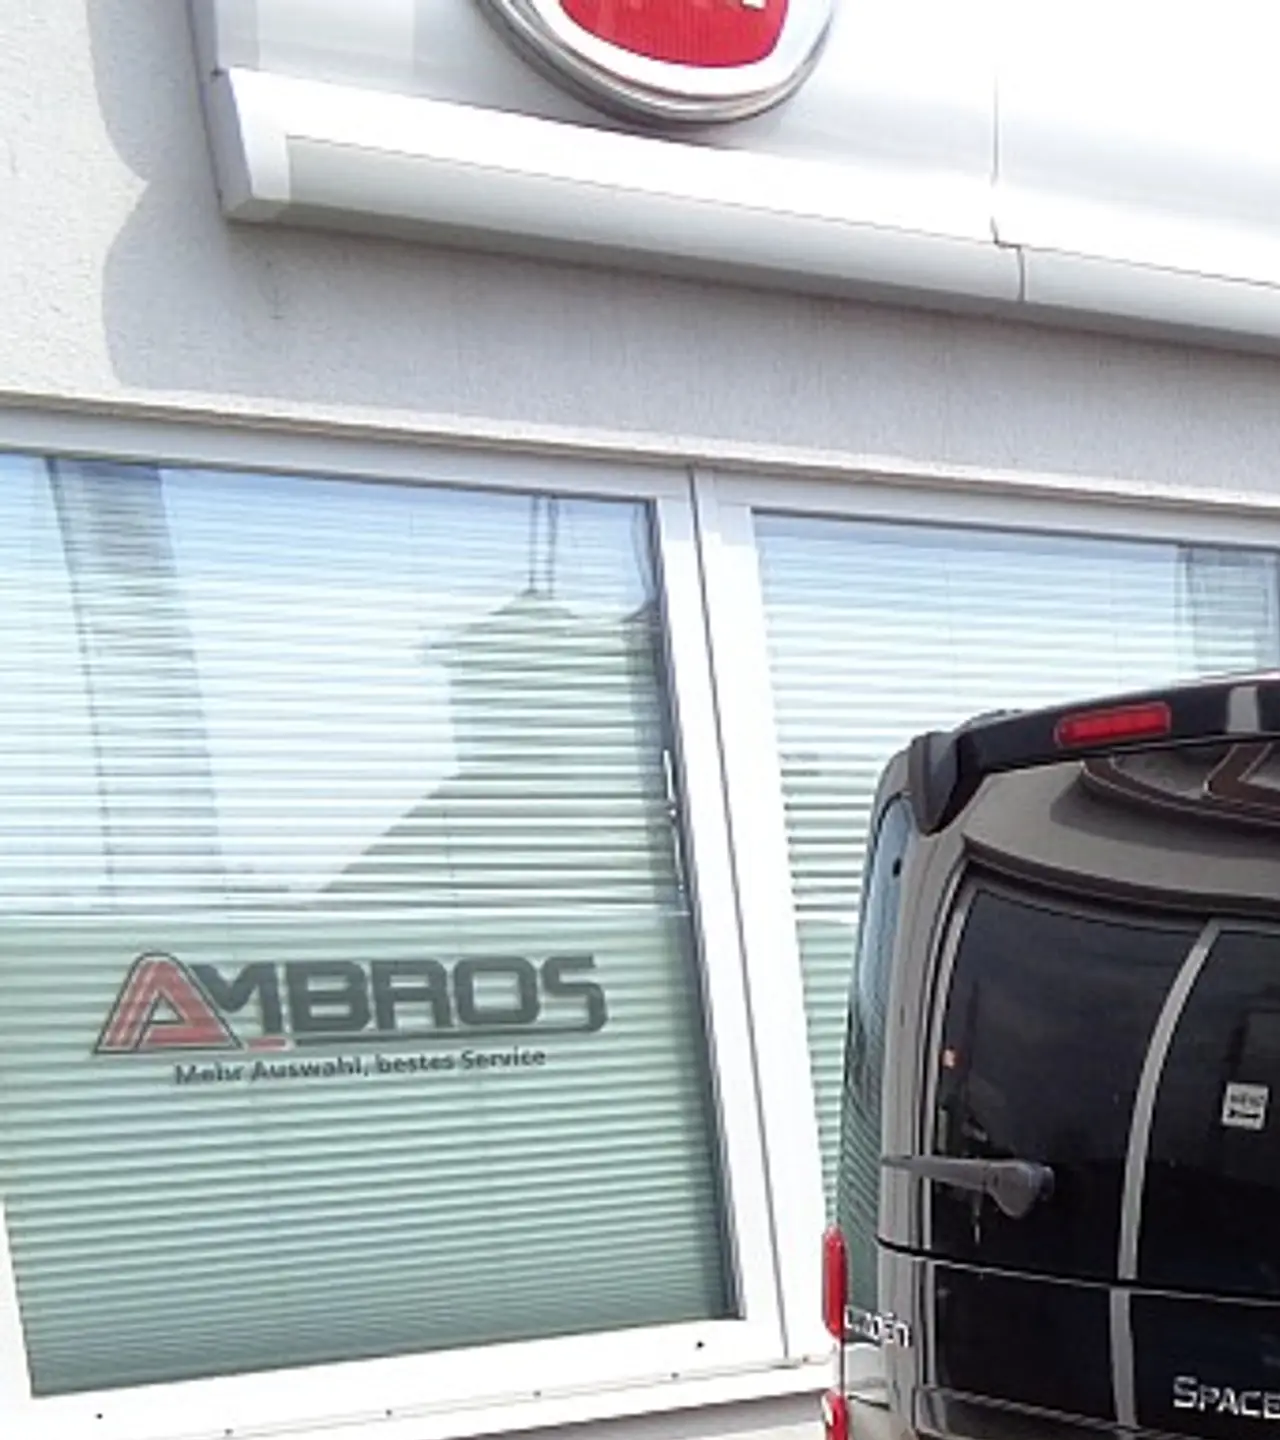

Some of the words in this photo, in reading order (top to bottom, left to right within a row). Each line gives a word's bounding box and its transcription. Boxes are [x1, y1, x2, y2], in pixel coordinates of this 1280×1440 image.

[93, 952, 608, 1055] AMBROS
[174, 1062, 245, 1084] Mehr
[250, 1057, 370, 1081] Auswahl,
[375, 1053, 455, 1075] bestes
[460, 1049, 546, 1069] Service
